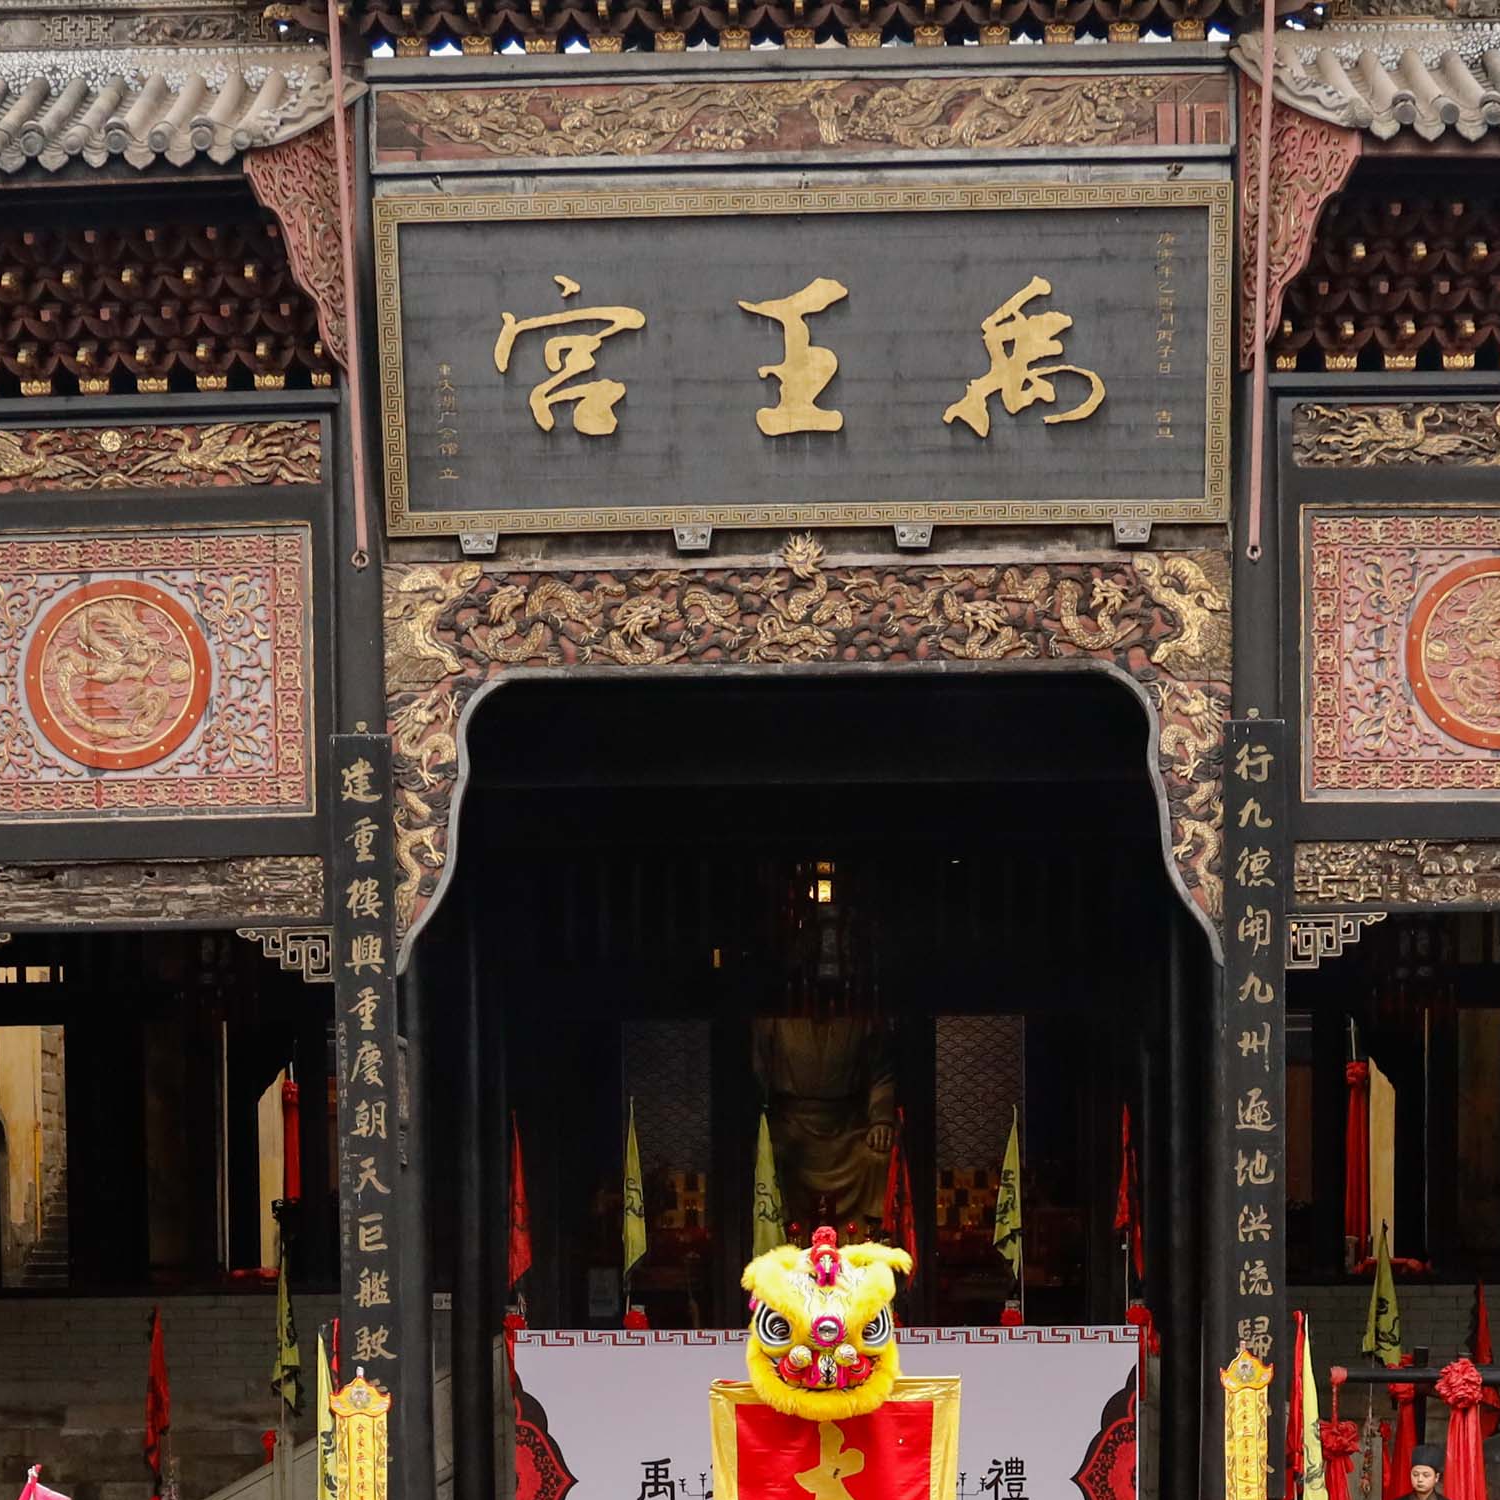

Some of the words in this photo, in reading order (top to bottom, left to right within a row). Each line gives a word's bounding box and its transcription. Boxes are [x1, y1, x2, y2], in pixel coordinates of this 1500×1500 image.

[341, 758, 398, 1392] 建重樓興重慶朝天巨艦駛
